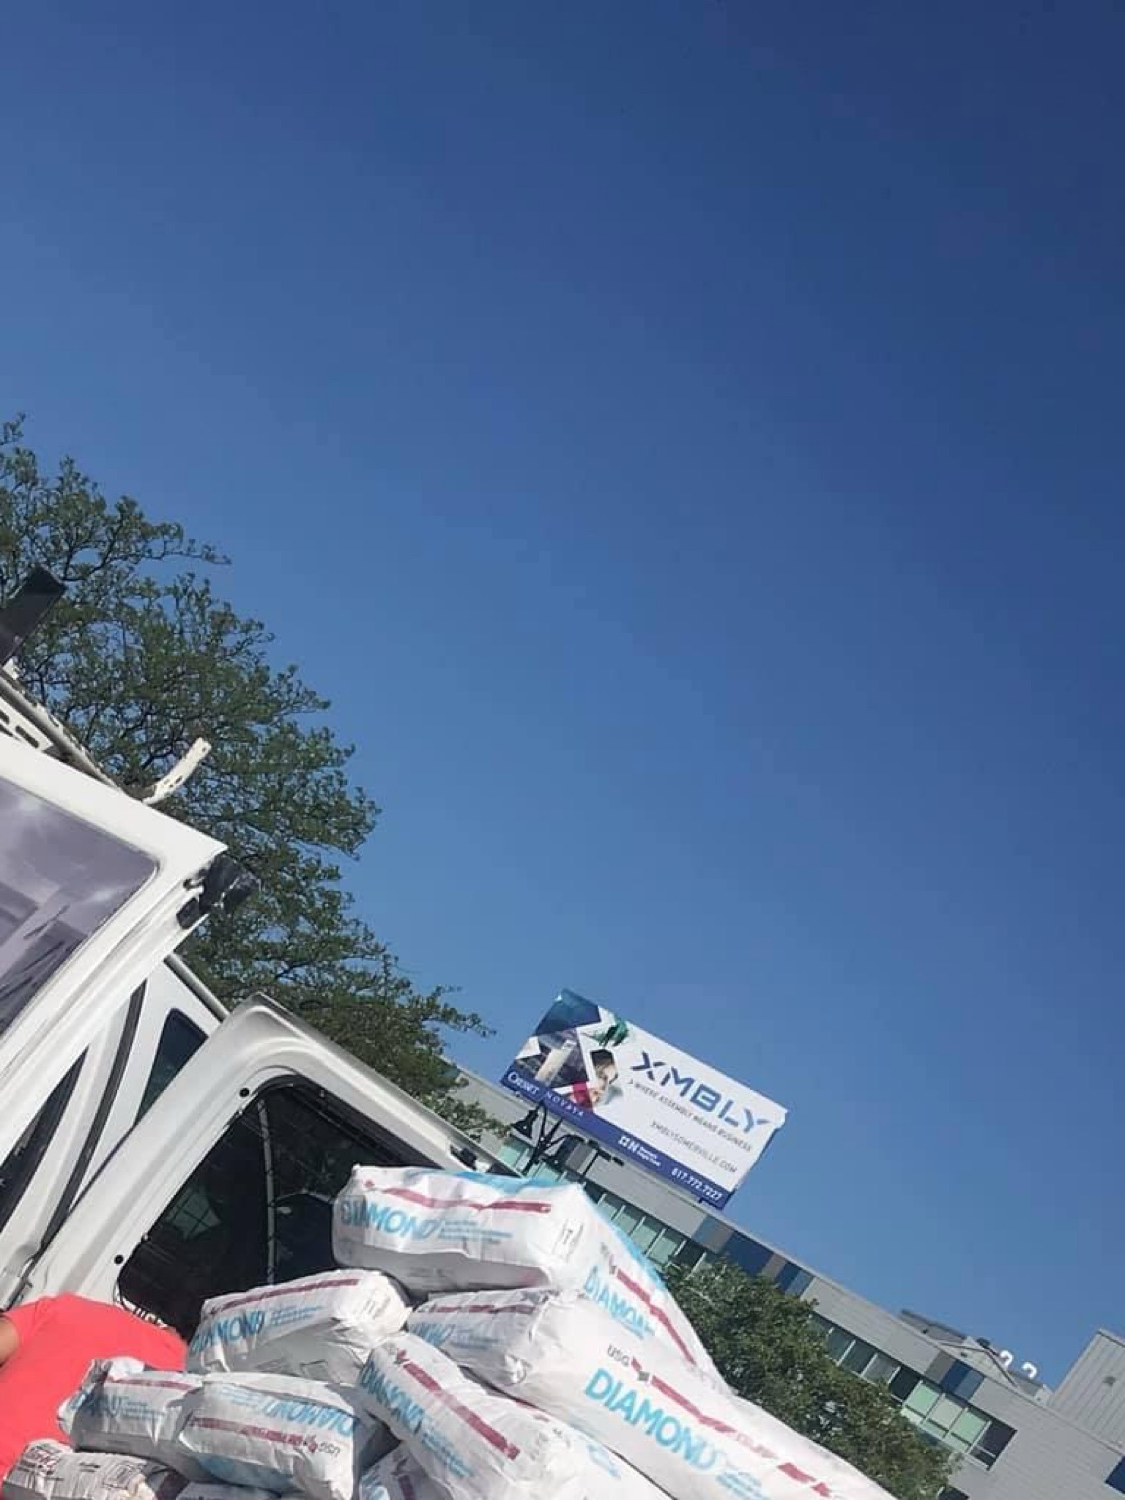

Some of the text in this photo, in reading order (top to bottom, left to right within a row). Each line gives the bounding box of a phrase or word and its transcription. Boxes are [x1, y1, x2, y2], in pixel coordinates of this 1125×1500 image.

[629, 1051, 770, 1133] XMBLY
[607, 1344, 630, 1367] USG
[584, 1368, 718, 1471] DIAMOND
[318, 1441, 341, 1455] USG
